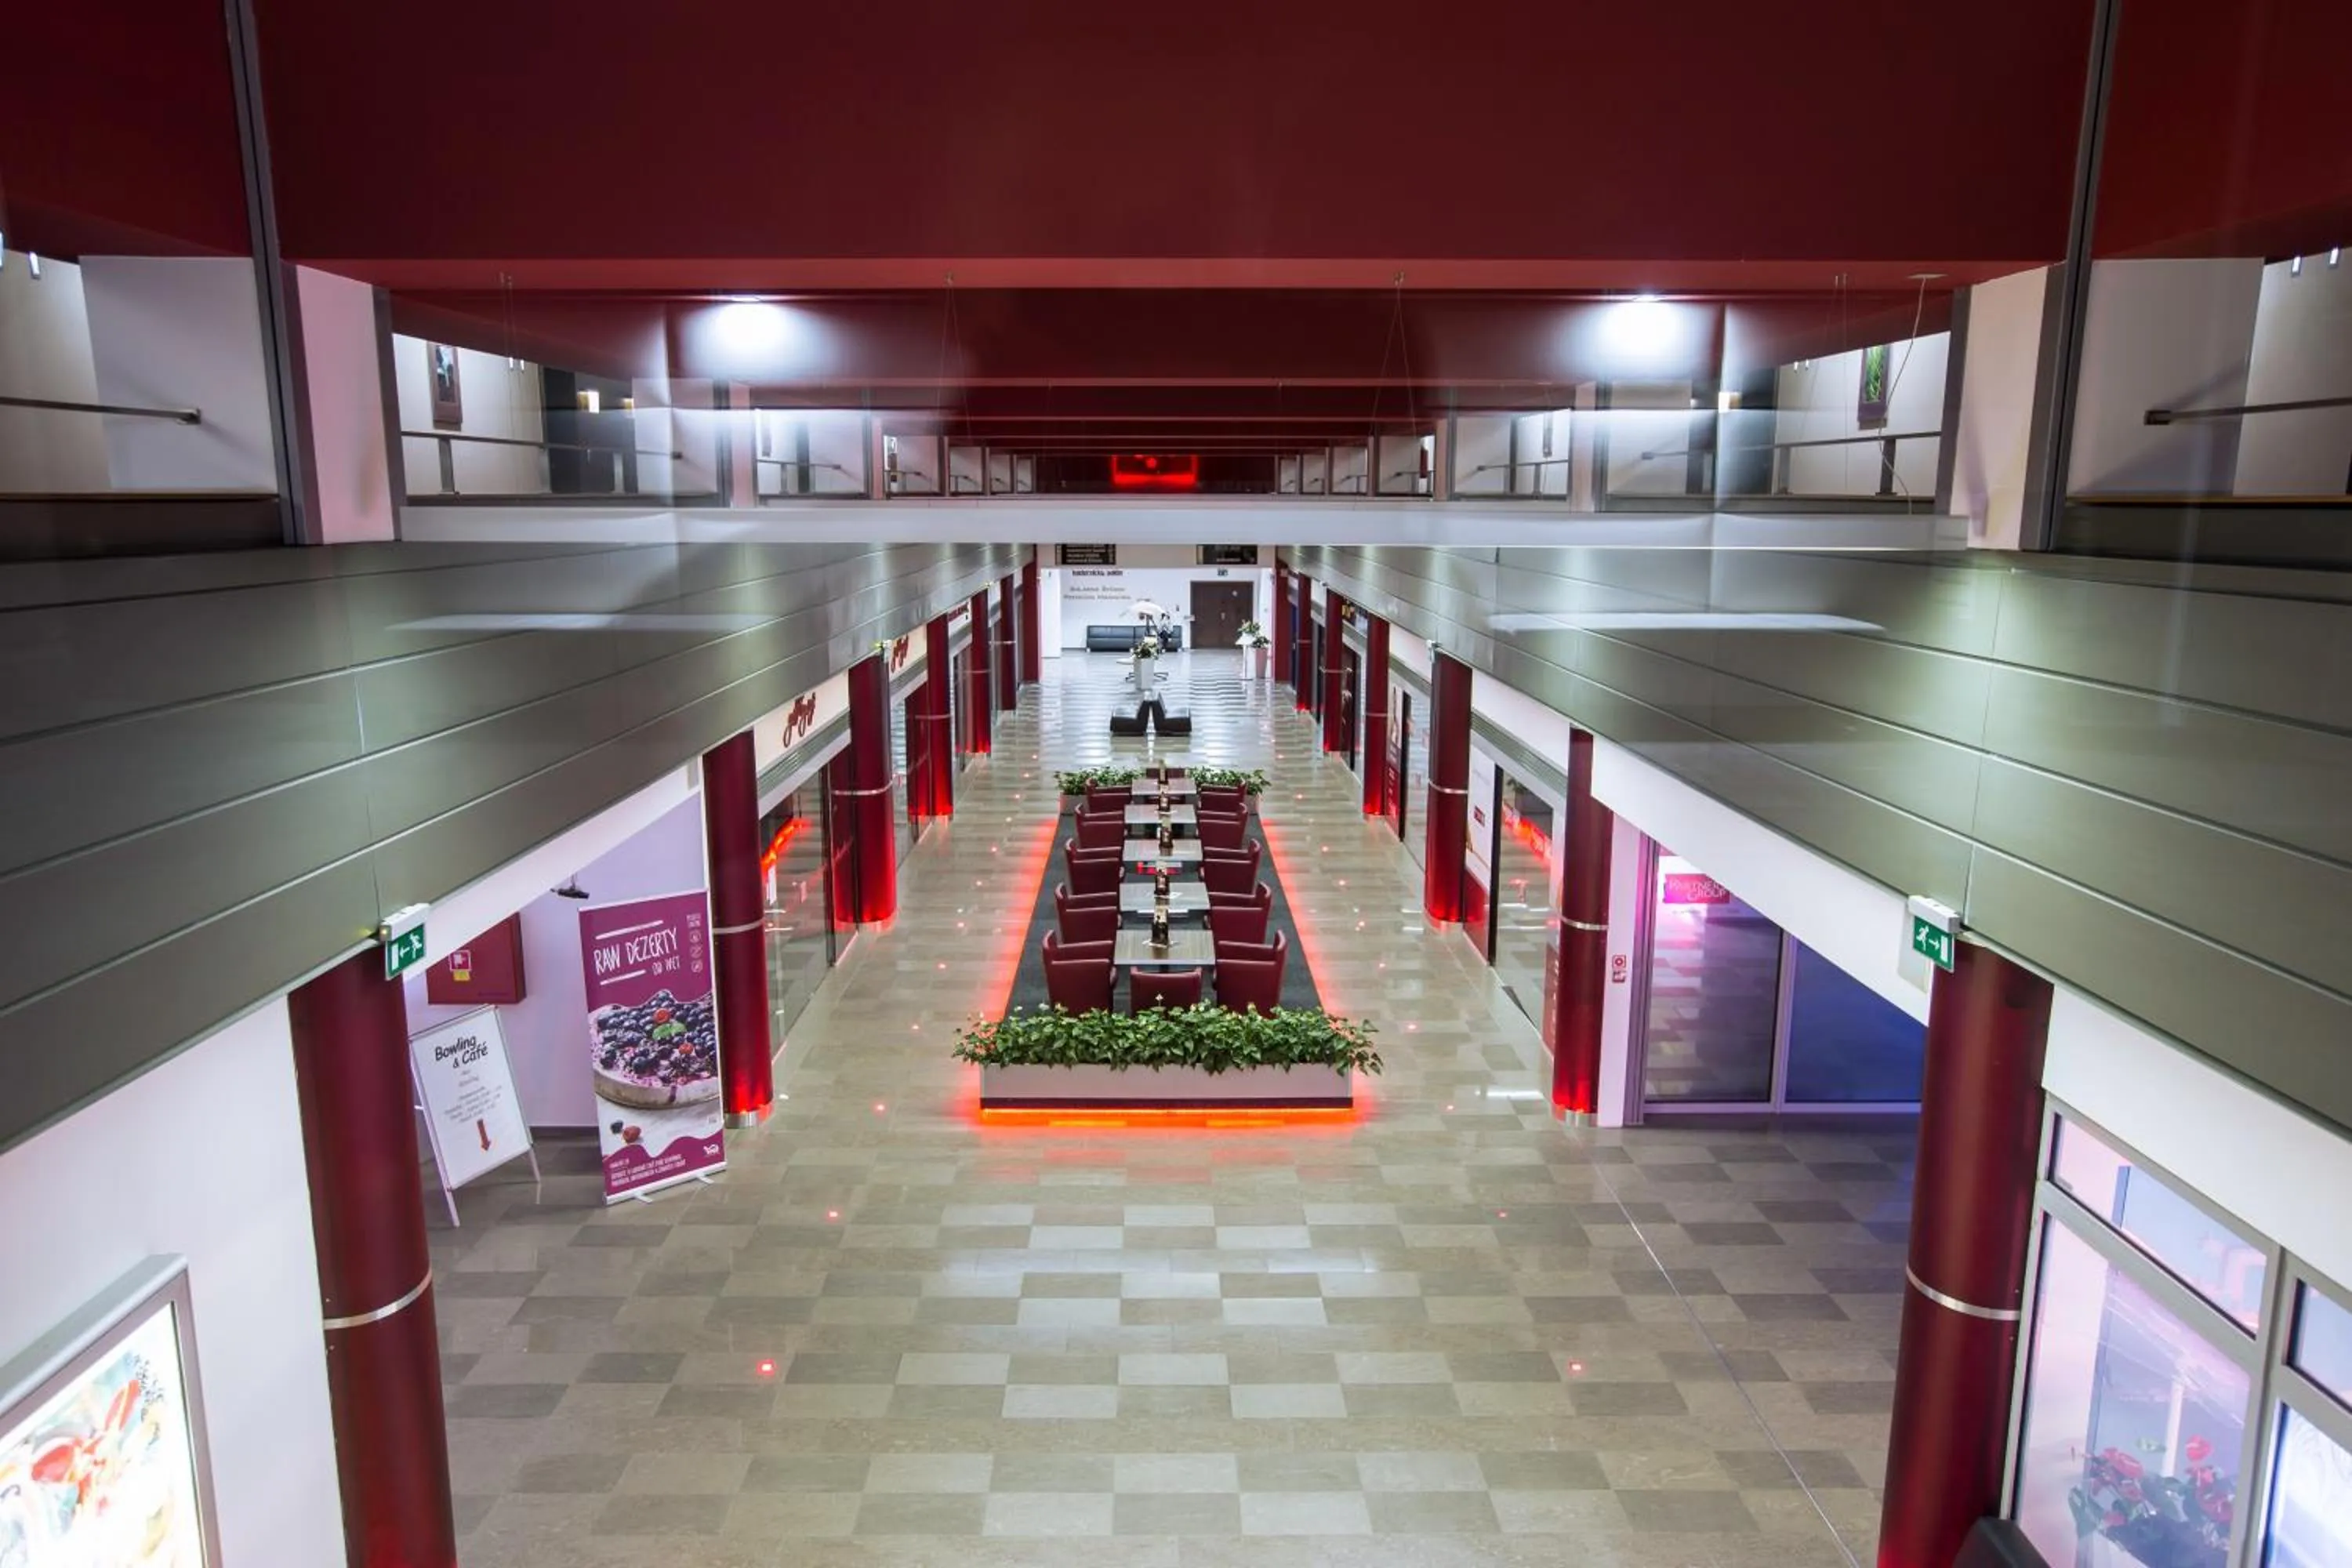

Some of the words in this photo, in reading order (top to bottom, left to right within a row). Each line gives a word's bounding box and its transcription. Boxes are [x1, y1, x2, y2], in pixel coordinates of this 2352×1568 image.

[593, 943, 620, 975] RAW
[626, 926, 677, 964] DEZERTY
[434, 1036, 476, 1062] Bowling
[452, 1057, 460, 1069] &
[462, 1040, 488, 1065] Café
